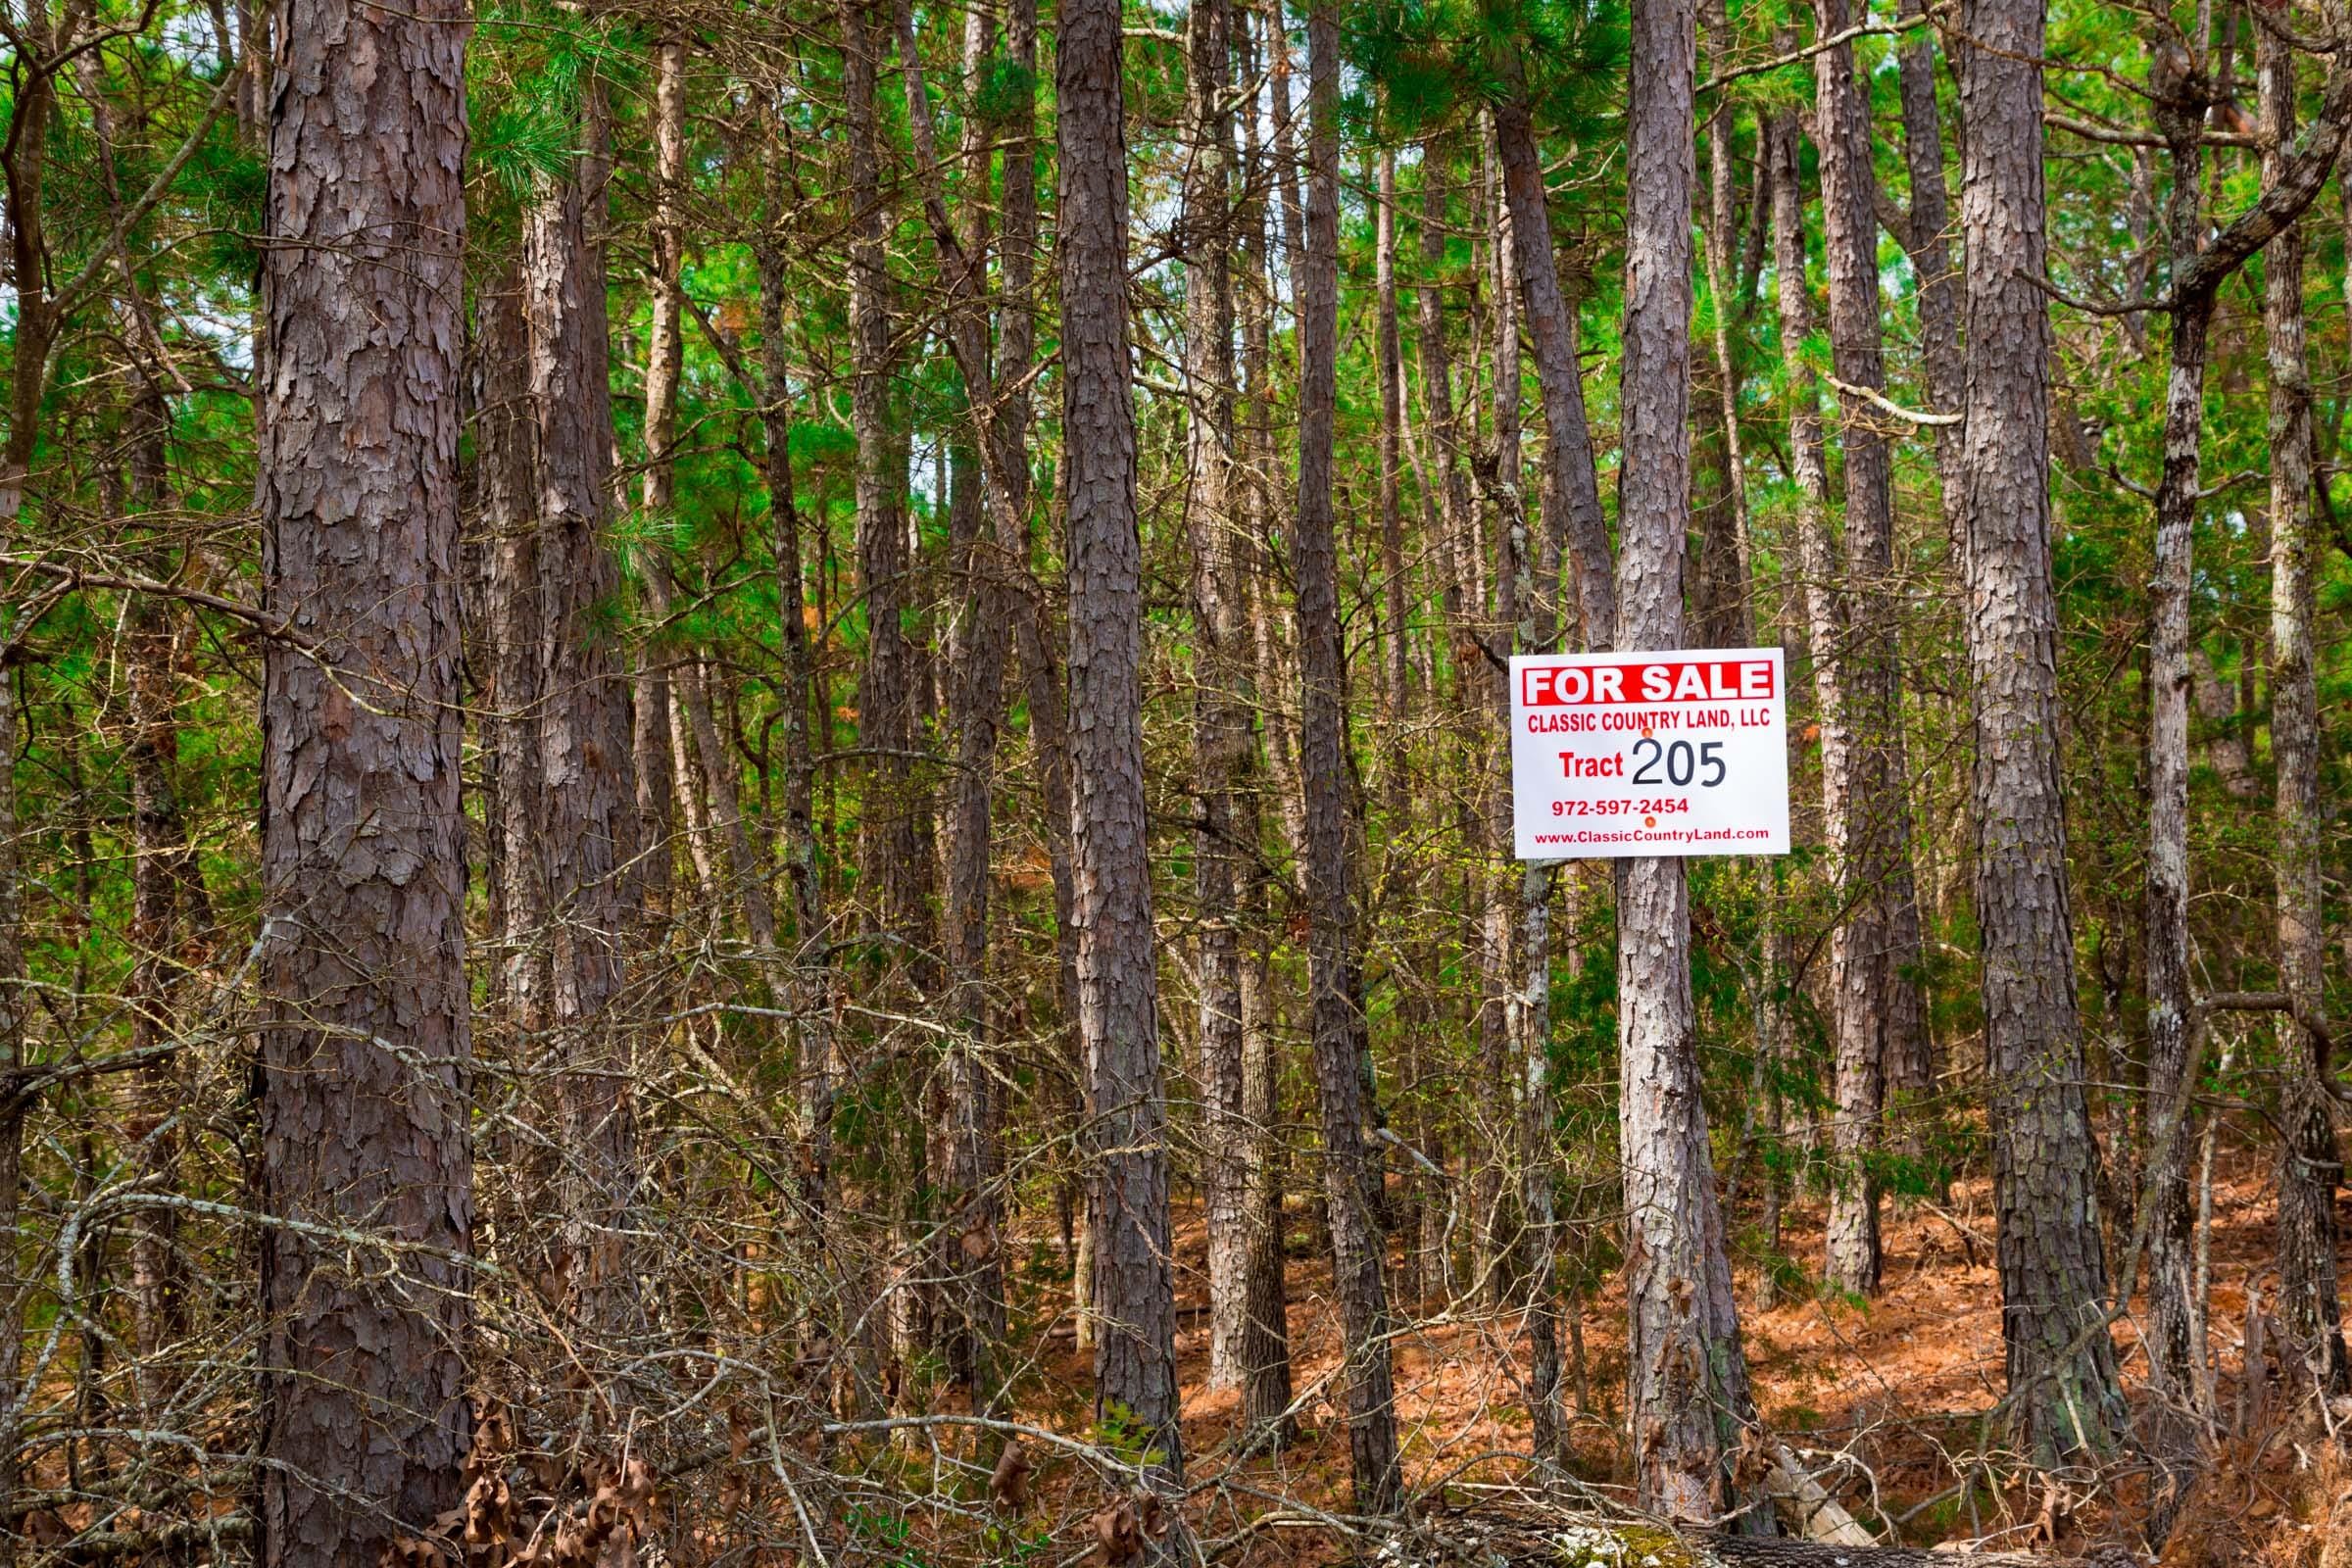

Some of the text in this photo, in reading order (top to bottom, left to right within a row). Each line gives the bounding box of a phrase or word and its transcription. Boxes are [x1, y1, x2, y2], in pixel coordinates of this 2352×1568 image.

[1526, 662, 1771, 705] FOR SALE
[1528, 708, 1771, 733] CLASSIC COUNTRY LAND, LLC
[1558, 738, 1727, 788] Tract 205
[1551, 798, 1690, 816] 972-597-2454
[1535, 828, 1770, 844] www.ClassicCountryLand.com
